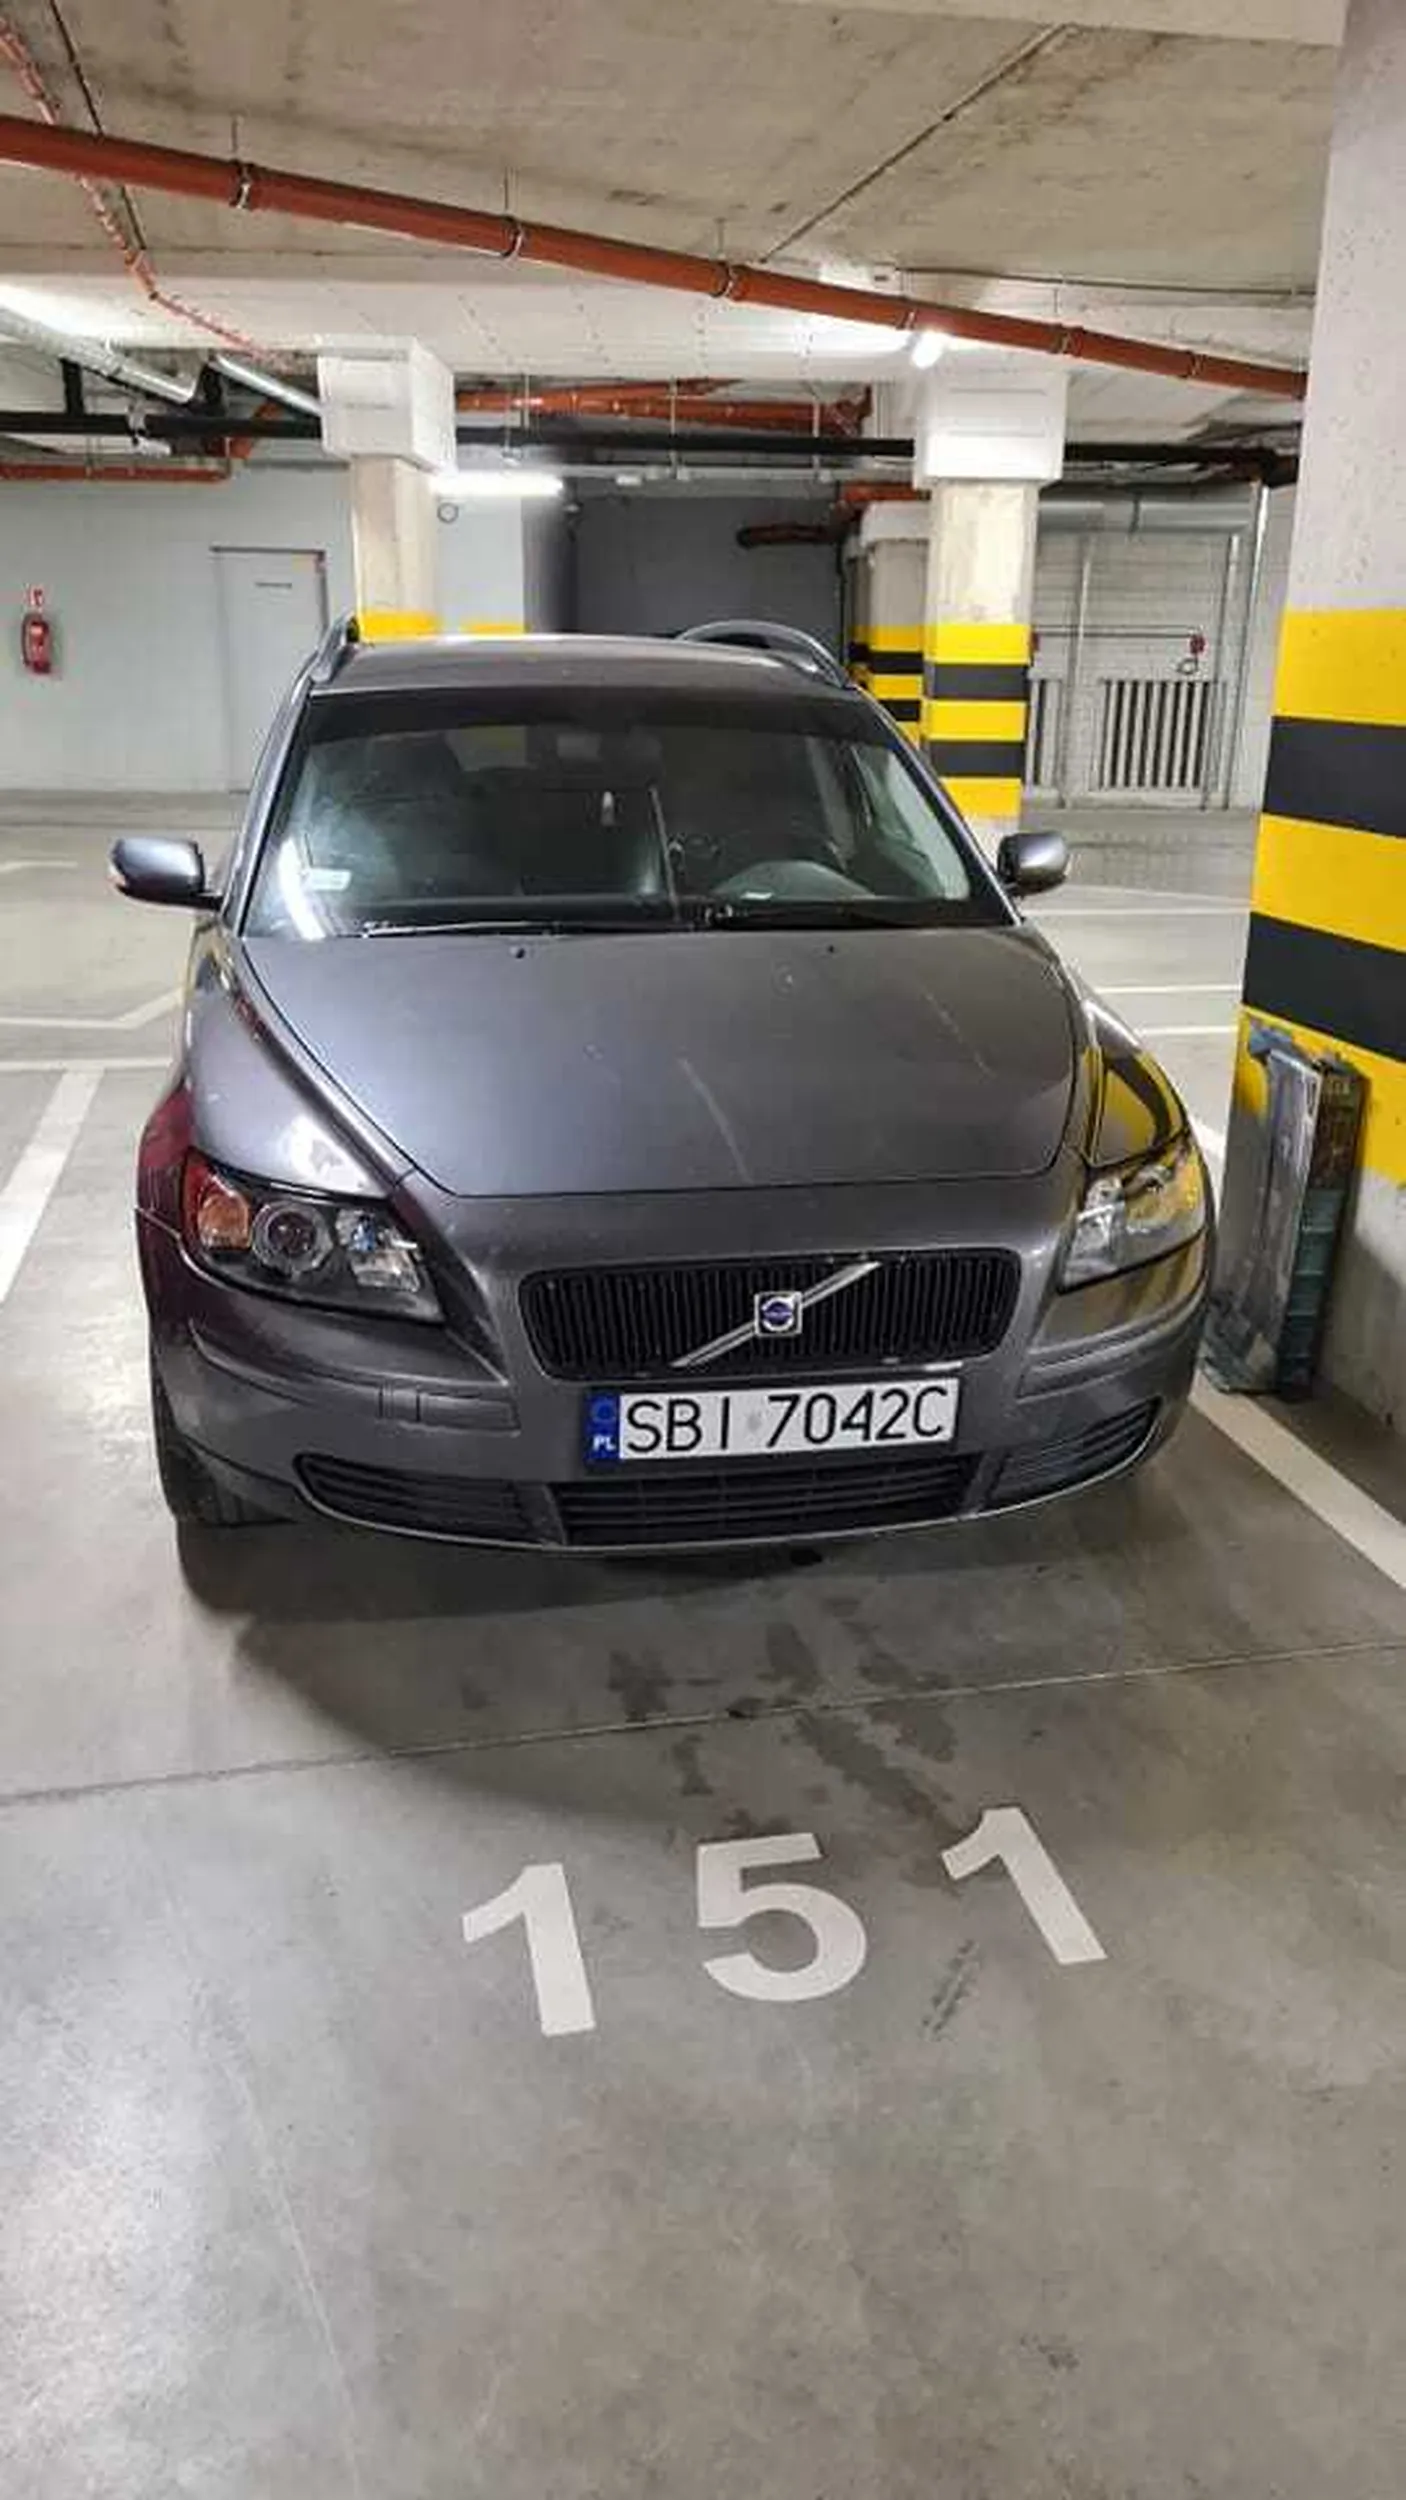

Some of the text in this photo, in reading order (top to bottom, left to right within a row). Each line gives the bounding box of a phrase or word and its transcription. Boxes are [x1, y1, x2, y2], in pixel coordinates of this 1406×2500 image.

[593, 1436, 616, 1452] PL
[626, 1386, 948, 1454] SBI 7042C
[462, 1806, 1107, 2037] 151
